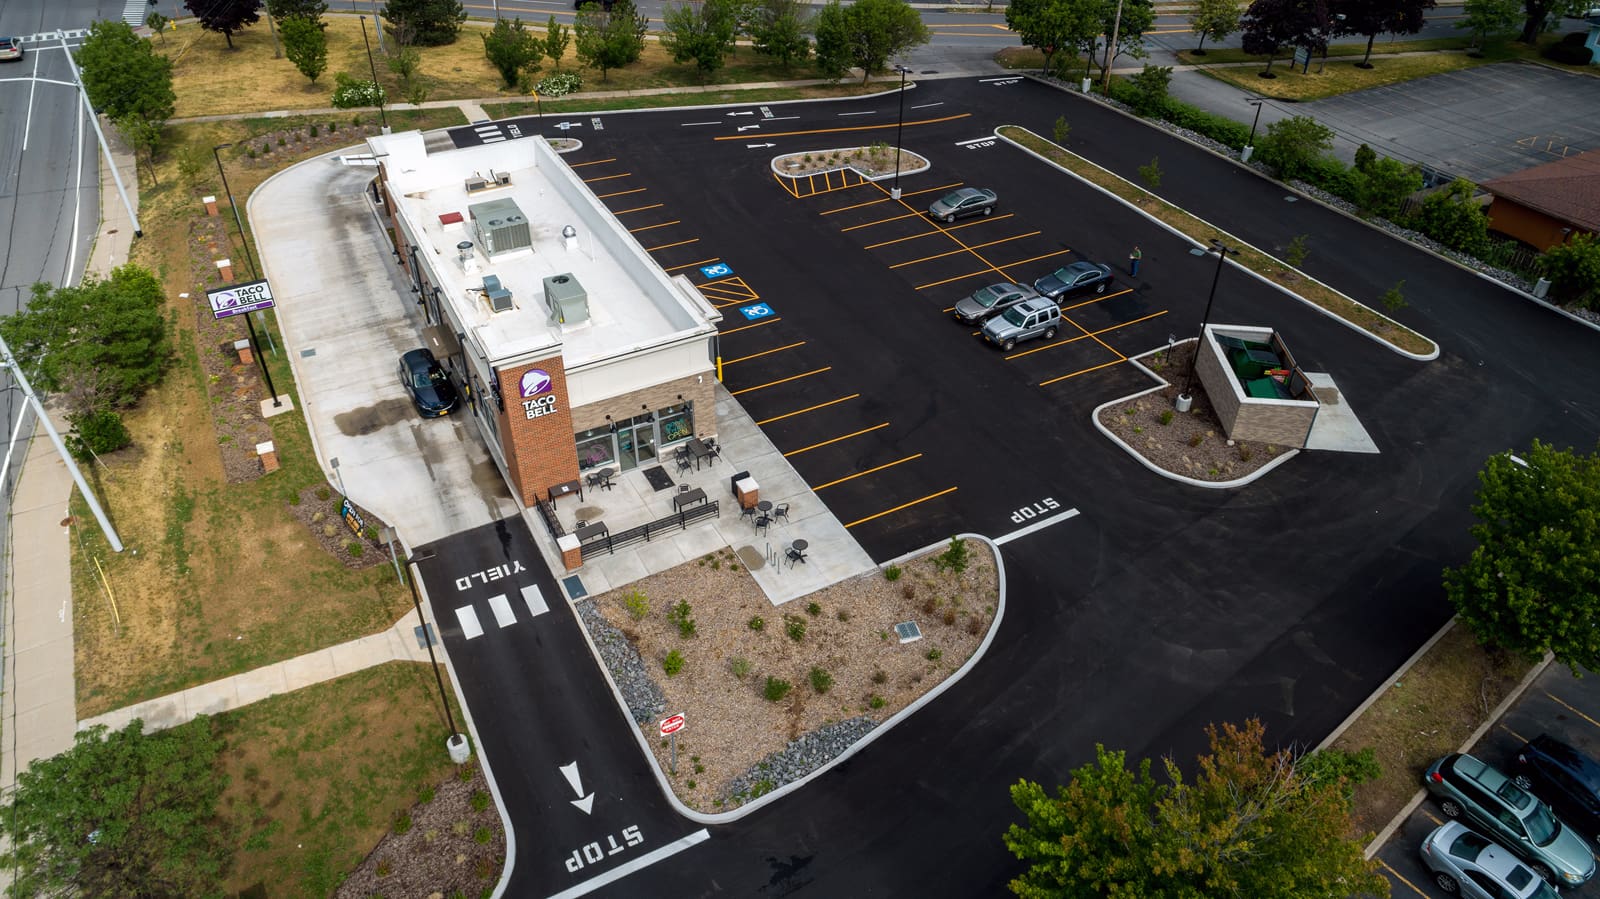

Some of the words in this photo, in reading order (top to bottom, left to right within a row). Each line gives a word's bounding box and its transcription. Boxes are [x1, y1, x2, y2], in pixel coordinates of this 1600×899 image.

[965, 140, 996, 150] STOP
[234, 285, 264, 297] TACO
[239, 293, 267, 305] BELL
[522, 394, 556, 411] TACO
[526, 404, 558, 420] BELL
[343, 499, 357, 517] OPEN
[1010, 497, 1061, 524] STOP
[455, 560, 527, 592] YIELD
[564, 824, 645, 873] STOP
